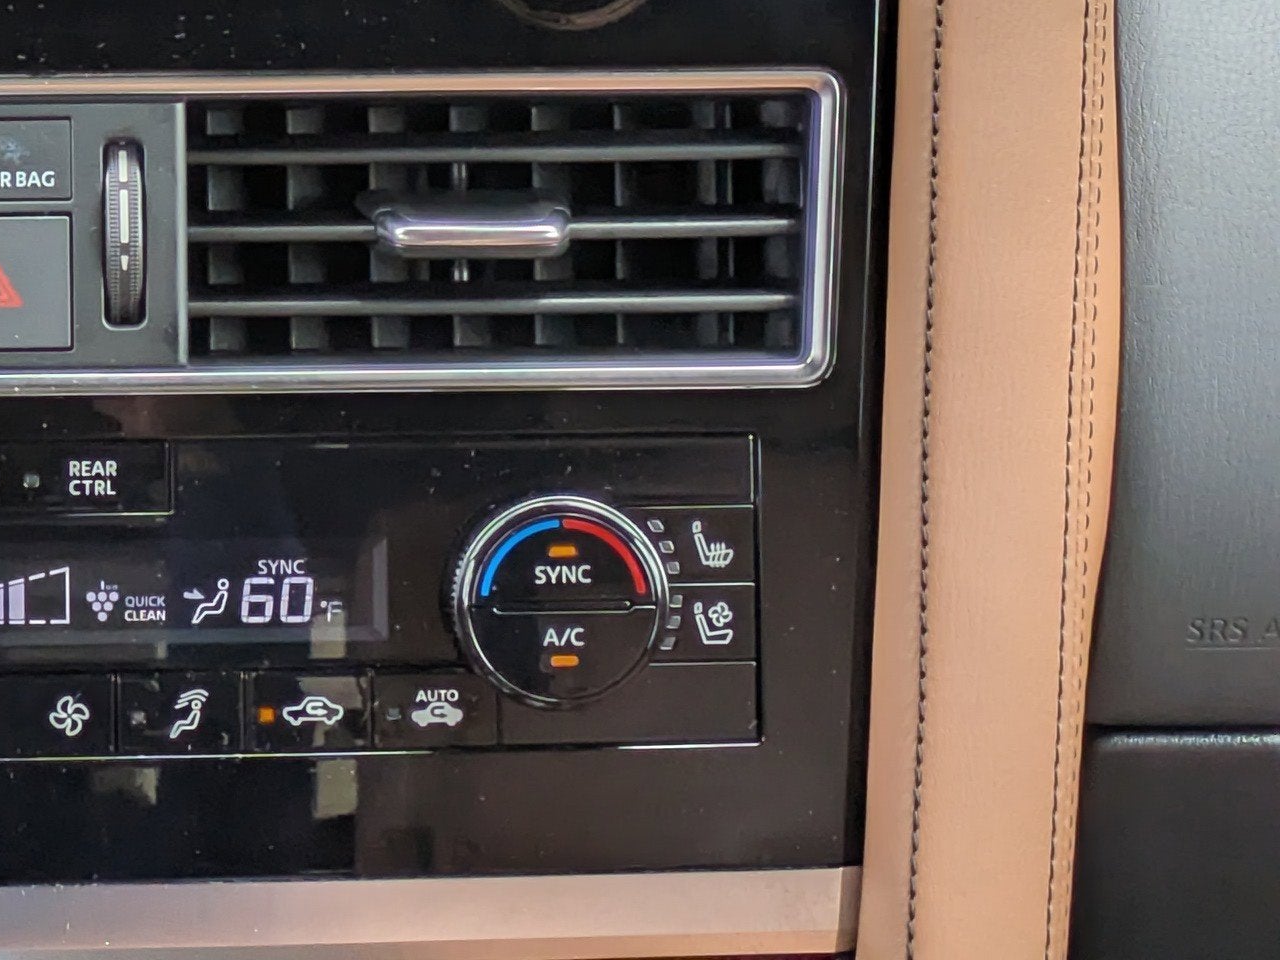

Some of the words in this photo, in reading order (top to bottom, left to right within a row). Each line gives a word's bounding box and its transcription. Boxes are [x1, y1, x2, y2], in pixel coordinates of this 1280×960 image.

[15, 170, 56, 187] BAG
[69, 460, 117, 477] REAR
[69, 480, 117, 496] CTRL
[257, 559, 306, 575] SYNC
[535, 565, 592, 584] SYNC
[125, 595, 166, 609] QUICK
[124, 610, 166, 623] CLEAN
[543, 628, 585, 646] A/C
[1185, 617, 1249, 642] SRS
[415, 689, 459, 702] AUTO
